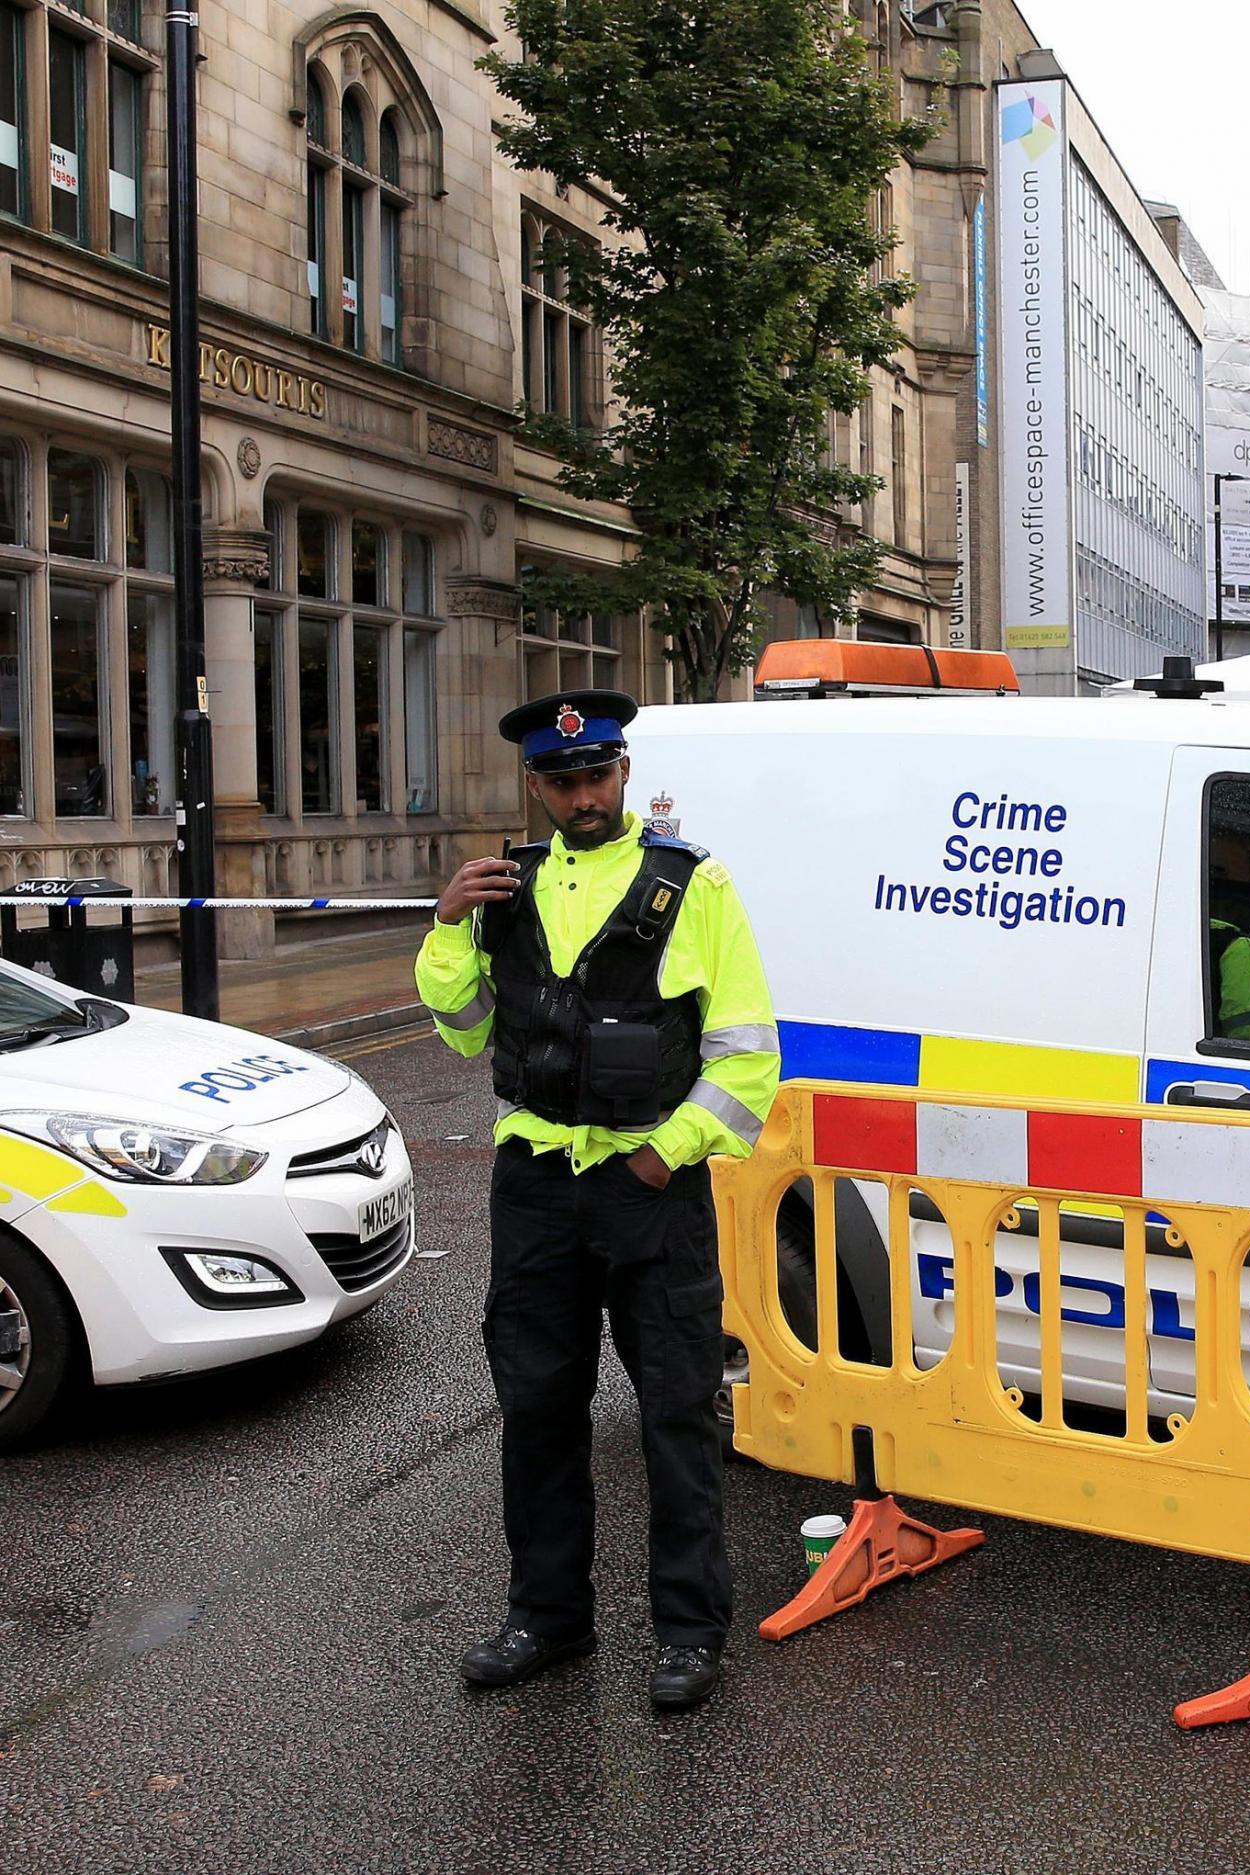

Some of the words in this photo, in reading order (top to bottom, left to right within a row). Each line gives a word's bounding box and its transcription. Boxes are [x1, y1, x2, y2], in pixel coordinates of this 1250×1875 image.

[148, 323, 328, 420] KTSOURIS
[1019, 170, 1048, 617] www.officespace-manchester.com
[951, 791, 1067, 833] Crime
[942, 834, 1063, 877] Scene
[874, 874, 1126, 930] Investigation
[178, 1055, 310, 1103] POLICE
[365, 1191, 396, 1236] MX62
